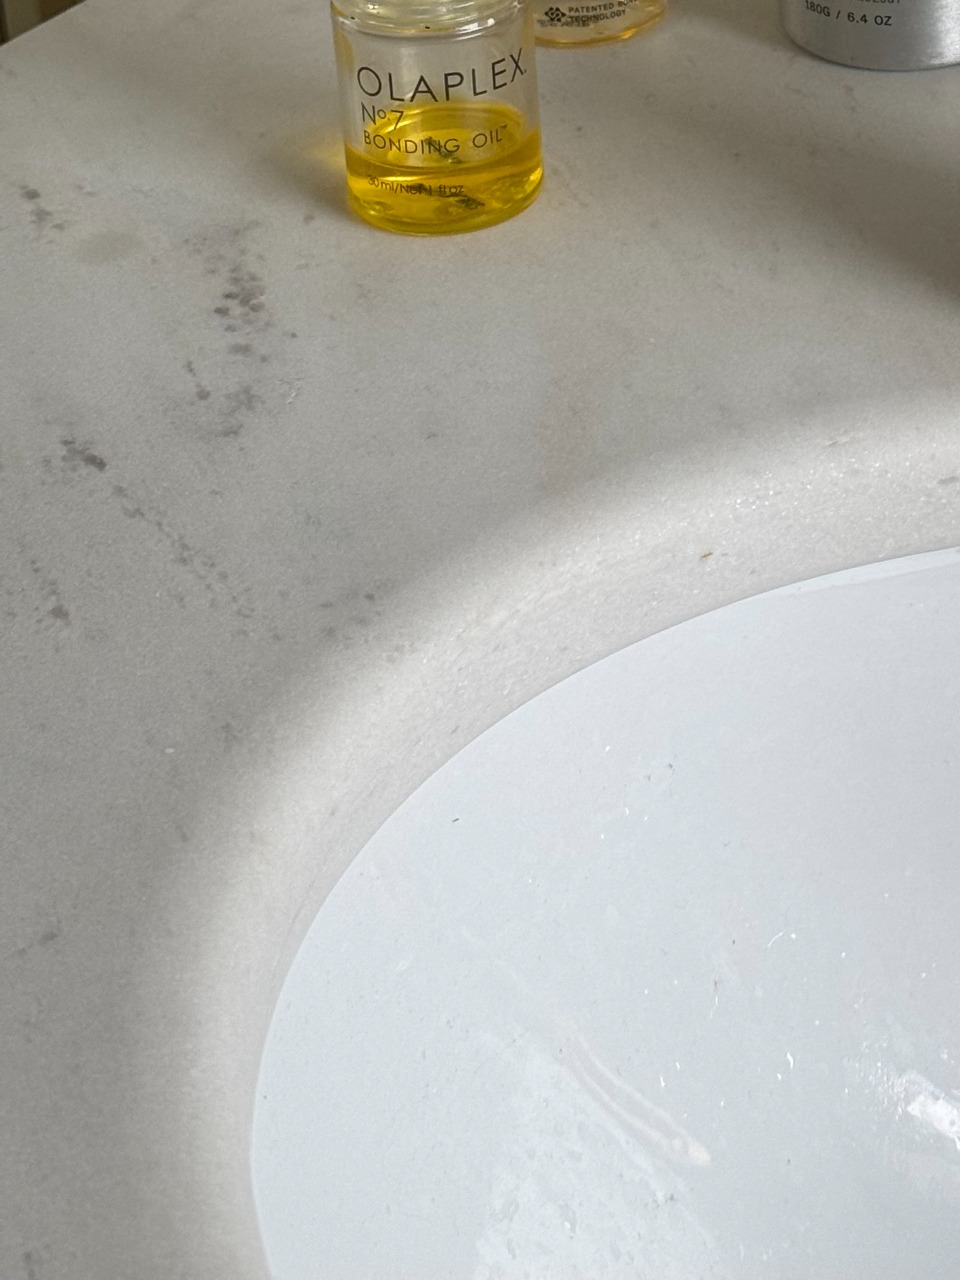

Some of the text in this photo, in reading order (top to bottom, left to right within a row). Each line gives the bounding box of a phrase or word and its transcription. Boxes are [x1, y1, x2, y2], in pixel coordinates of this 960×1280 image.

[568, 2, 614, 13] PATENTED
[805, 0, 892, 26] 180G / 6.4 OZ
[357, 47, 524, 103] OLAPLEX
[364, 130, 460, 154] BONDING
